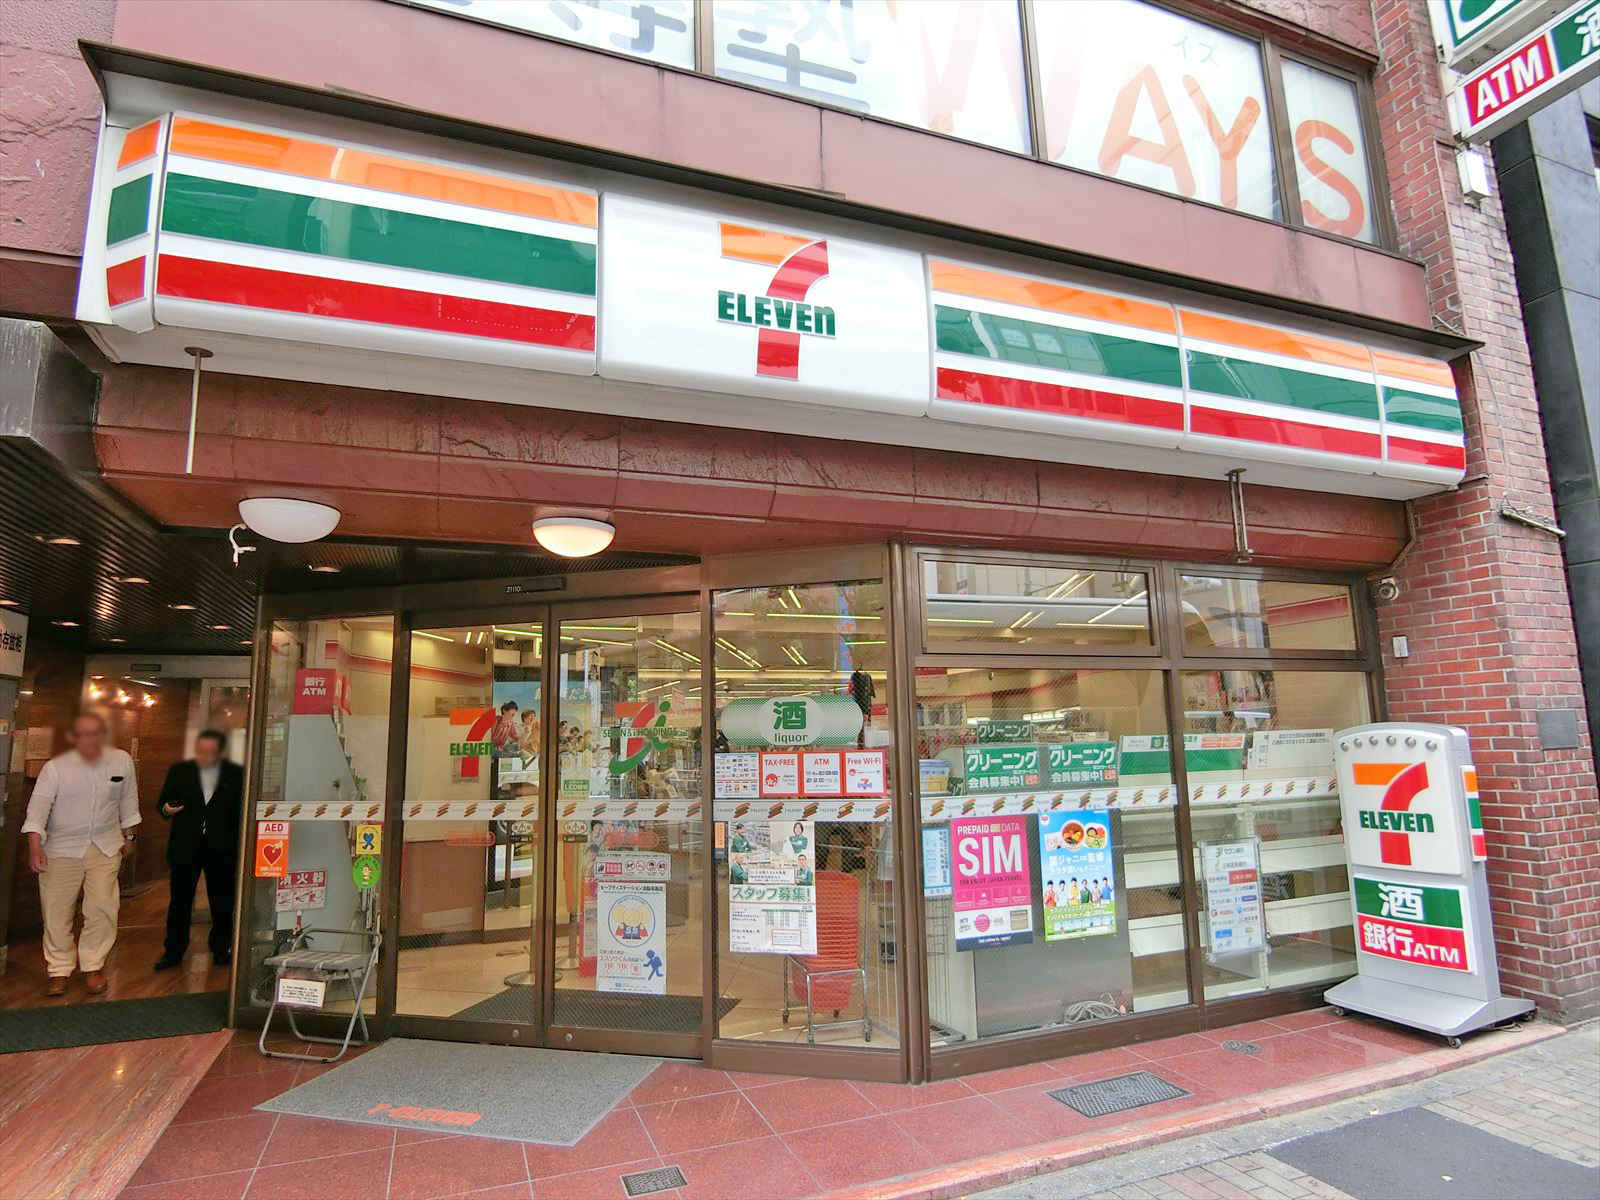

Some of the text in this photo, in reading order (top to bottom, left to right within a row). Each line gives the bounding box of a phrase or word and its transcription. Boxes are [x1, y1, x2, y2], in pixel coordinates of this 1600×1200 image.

[1477, 44, 1545, 118] ATM
[304, 676, 327, 687] 銀行
[302, 687, 327, 696] ATM
[773, 700, 807, 730] 酒
[979, 725, 1029, 738] クリーニング
[774, 733, 808, 744] liquor
[765, 758, 795, 766] TAX-FREE
[813, 758, 830, 766] ATM
[863, 757, 881, 765] Wi-Fi
[967, 751, 1038, 772] クリーニング
[1050, 747, 1115, 767] クリーニング
[264, 823, 284, 833] AED
[957, 822, 1020, 835] PREPAID DATA
[958, 834, 1023, 877] SIM
[732, 886, 812, 902] スタッフ募集!
[1378, 882, 1424, 921] 酒
[1362, 920, 1459, 964] 銀行 ATM
